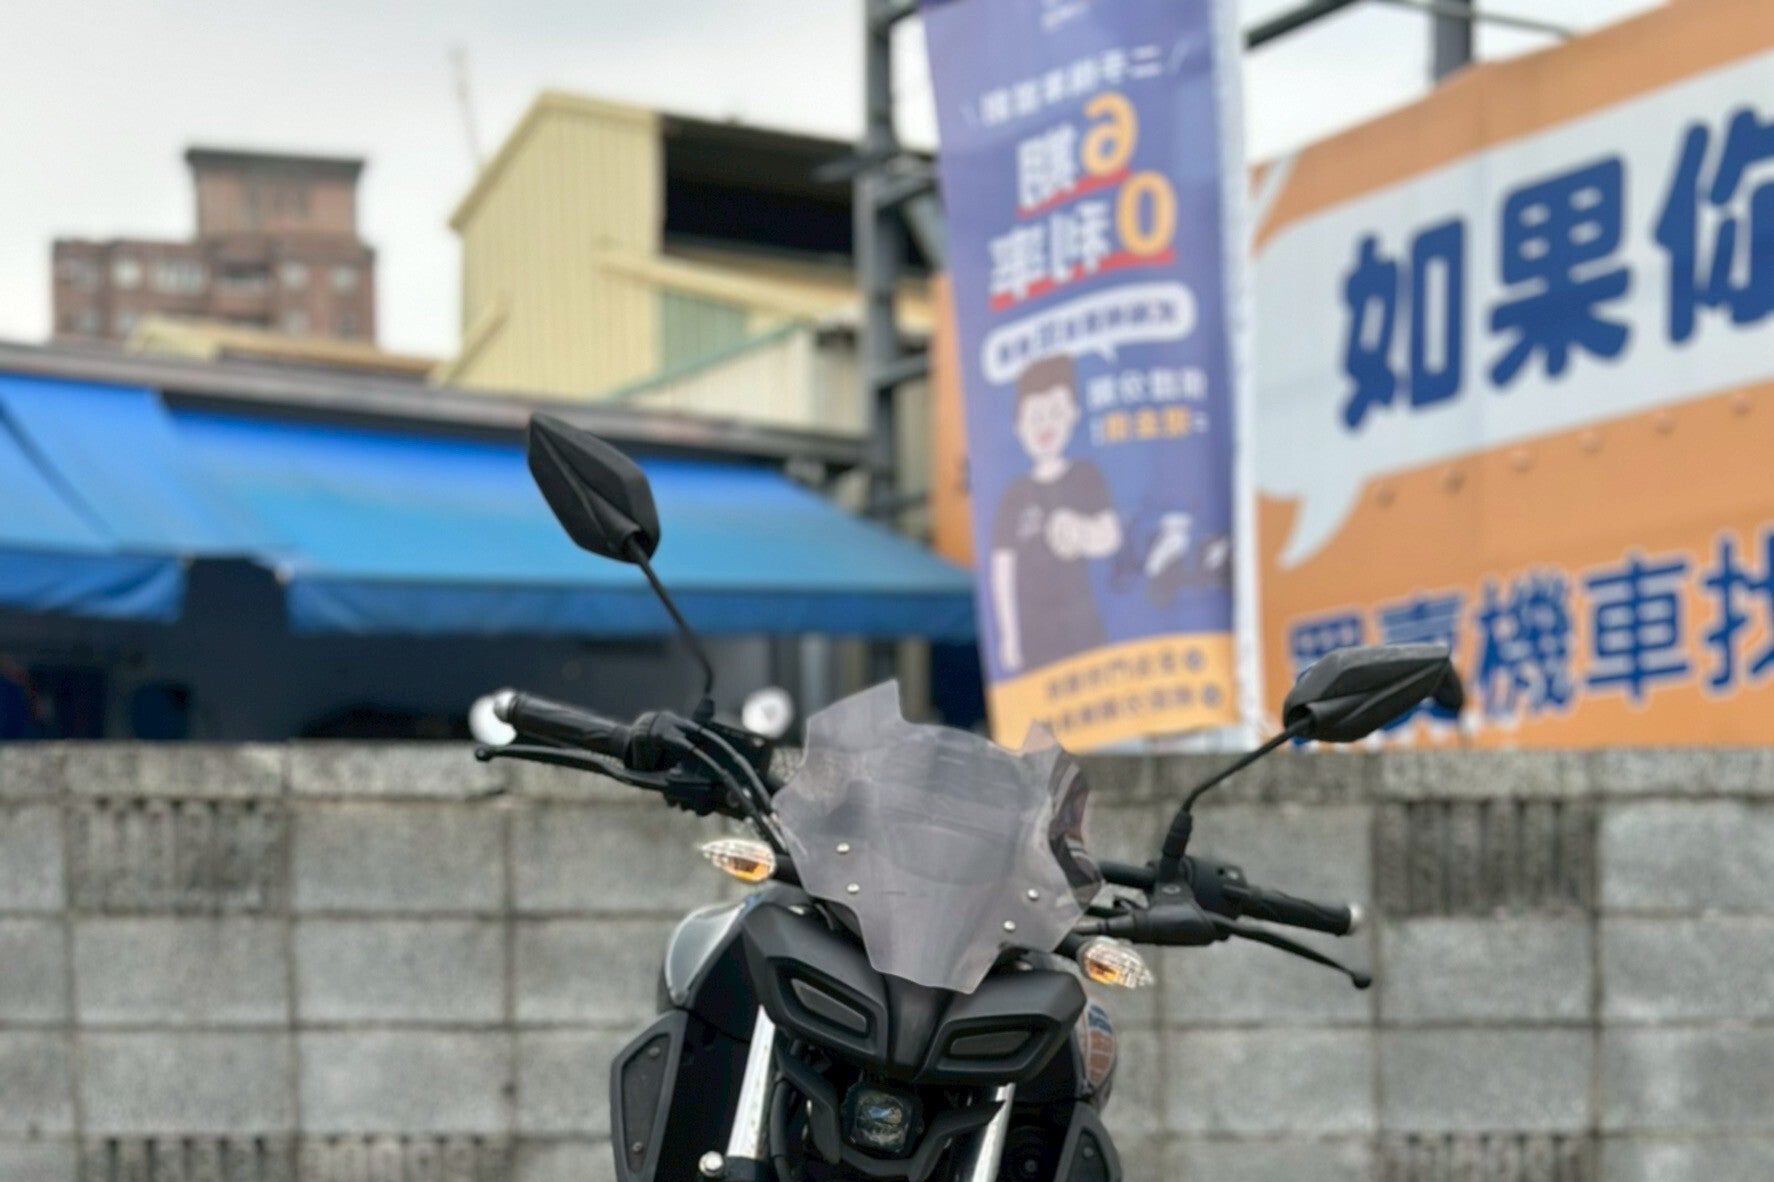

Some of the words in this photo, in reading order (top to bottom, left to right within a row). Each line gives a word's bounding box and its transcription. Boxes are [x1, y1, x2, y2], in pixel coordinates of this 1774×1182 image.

[1342, 107, 1774, 430] 如果你
[1290, 532, 1774, 746] 機車找
